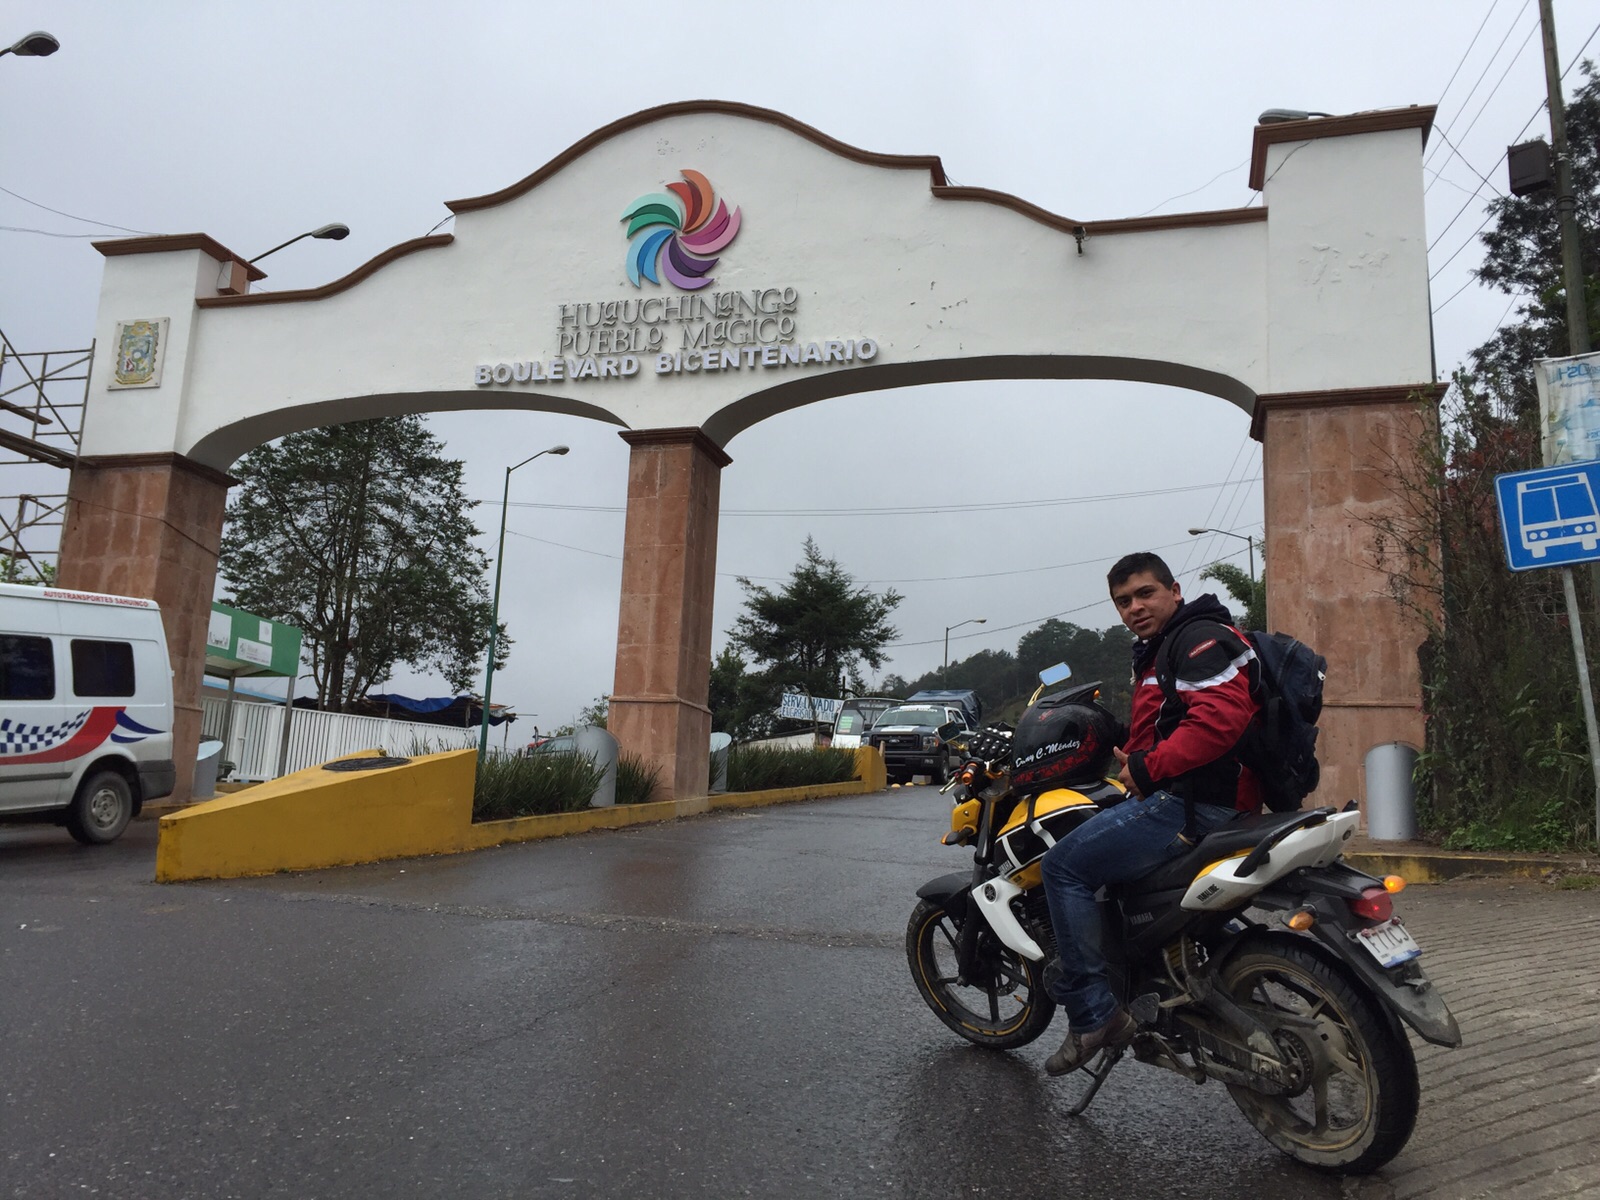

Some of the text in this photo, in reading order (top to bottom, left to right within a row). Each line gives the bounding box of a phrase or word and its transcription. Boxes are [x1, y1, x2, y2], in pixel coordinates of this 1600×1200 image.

[474, 338, 879, 387] BOULEVARD BICENTENARIO
[43, 590, 113, 603] AUTOTRANSPORTES
[1129, 911, 1155, 926] YAMAHA
